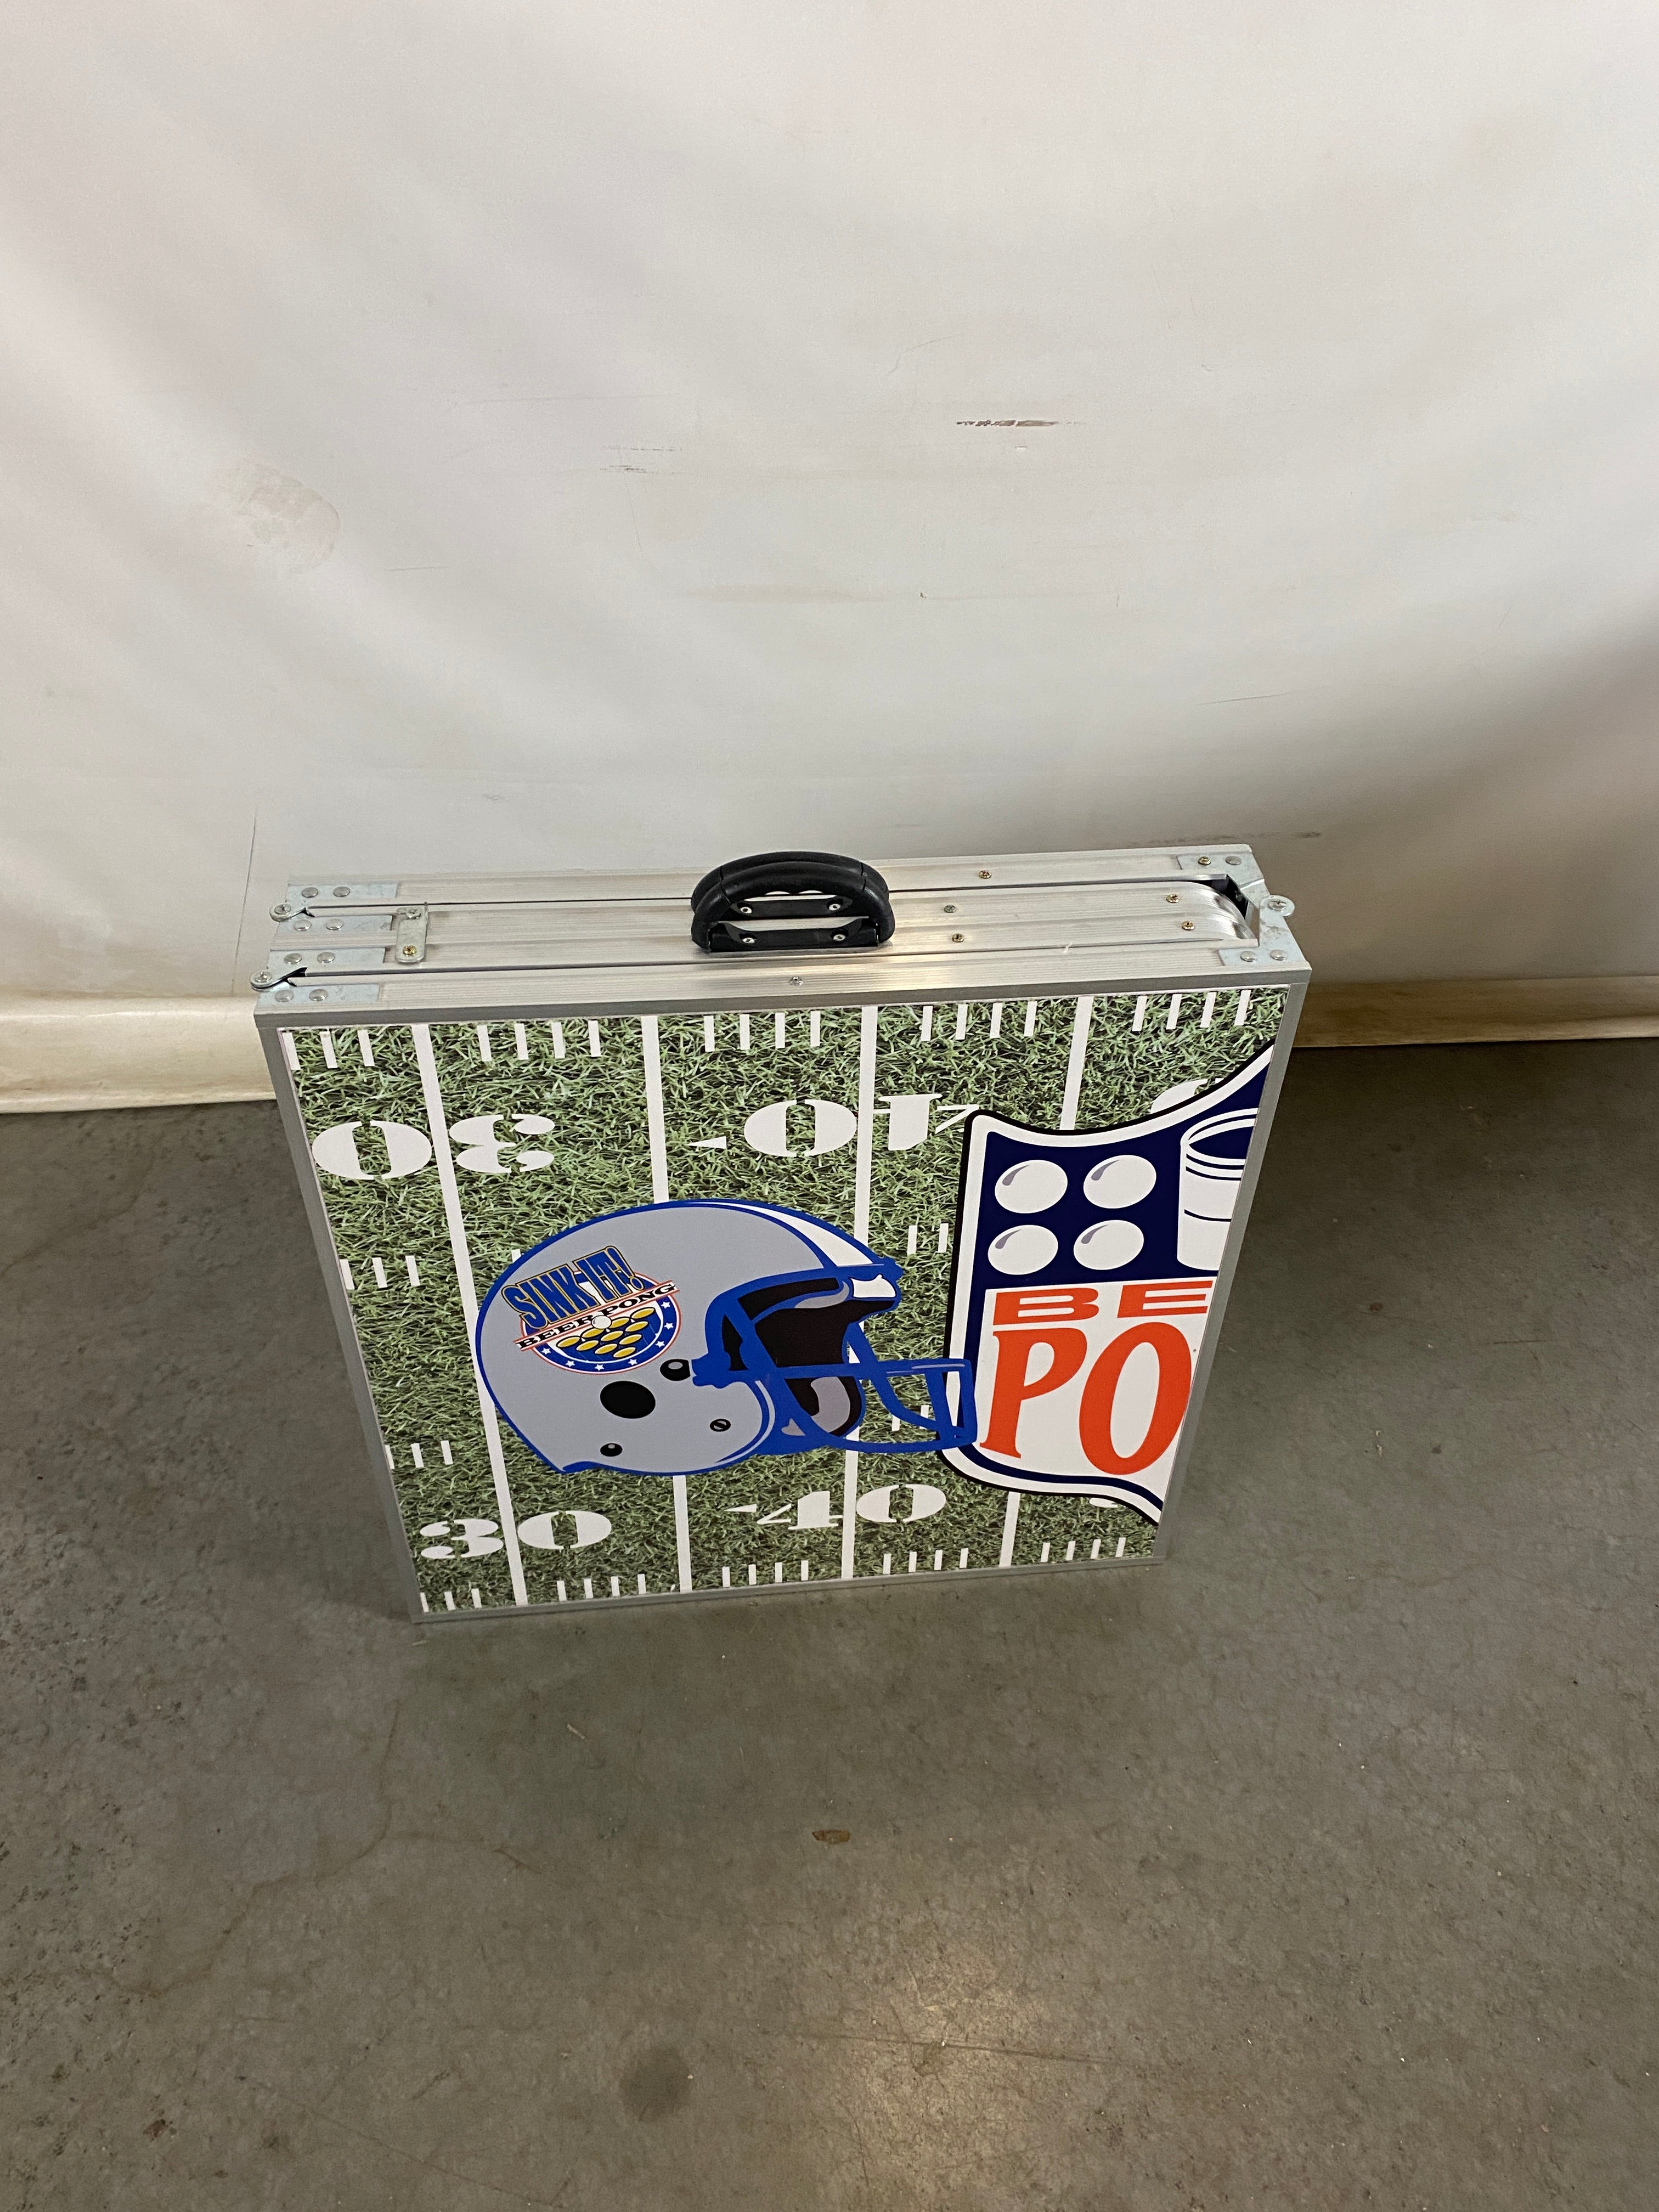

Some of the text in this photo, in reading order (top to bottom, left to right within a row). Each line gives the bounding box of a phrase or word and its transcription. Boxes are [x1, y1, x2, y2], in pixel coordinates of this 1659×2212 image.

[312, 1114, 555, 1180] 30
[744, 1093, 980, 1158] 40
[503, 1246, 644, 1329] SINK IT!
[518, 1283, 675, 1348] BEER PONG
[993, 1280, 1213, 1325] BE
[980, 1322, 1192, 1475] PO
[420, 1510, 612, 1559] 30
[757, 1484, 946, 1531] 40
